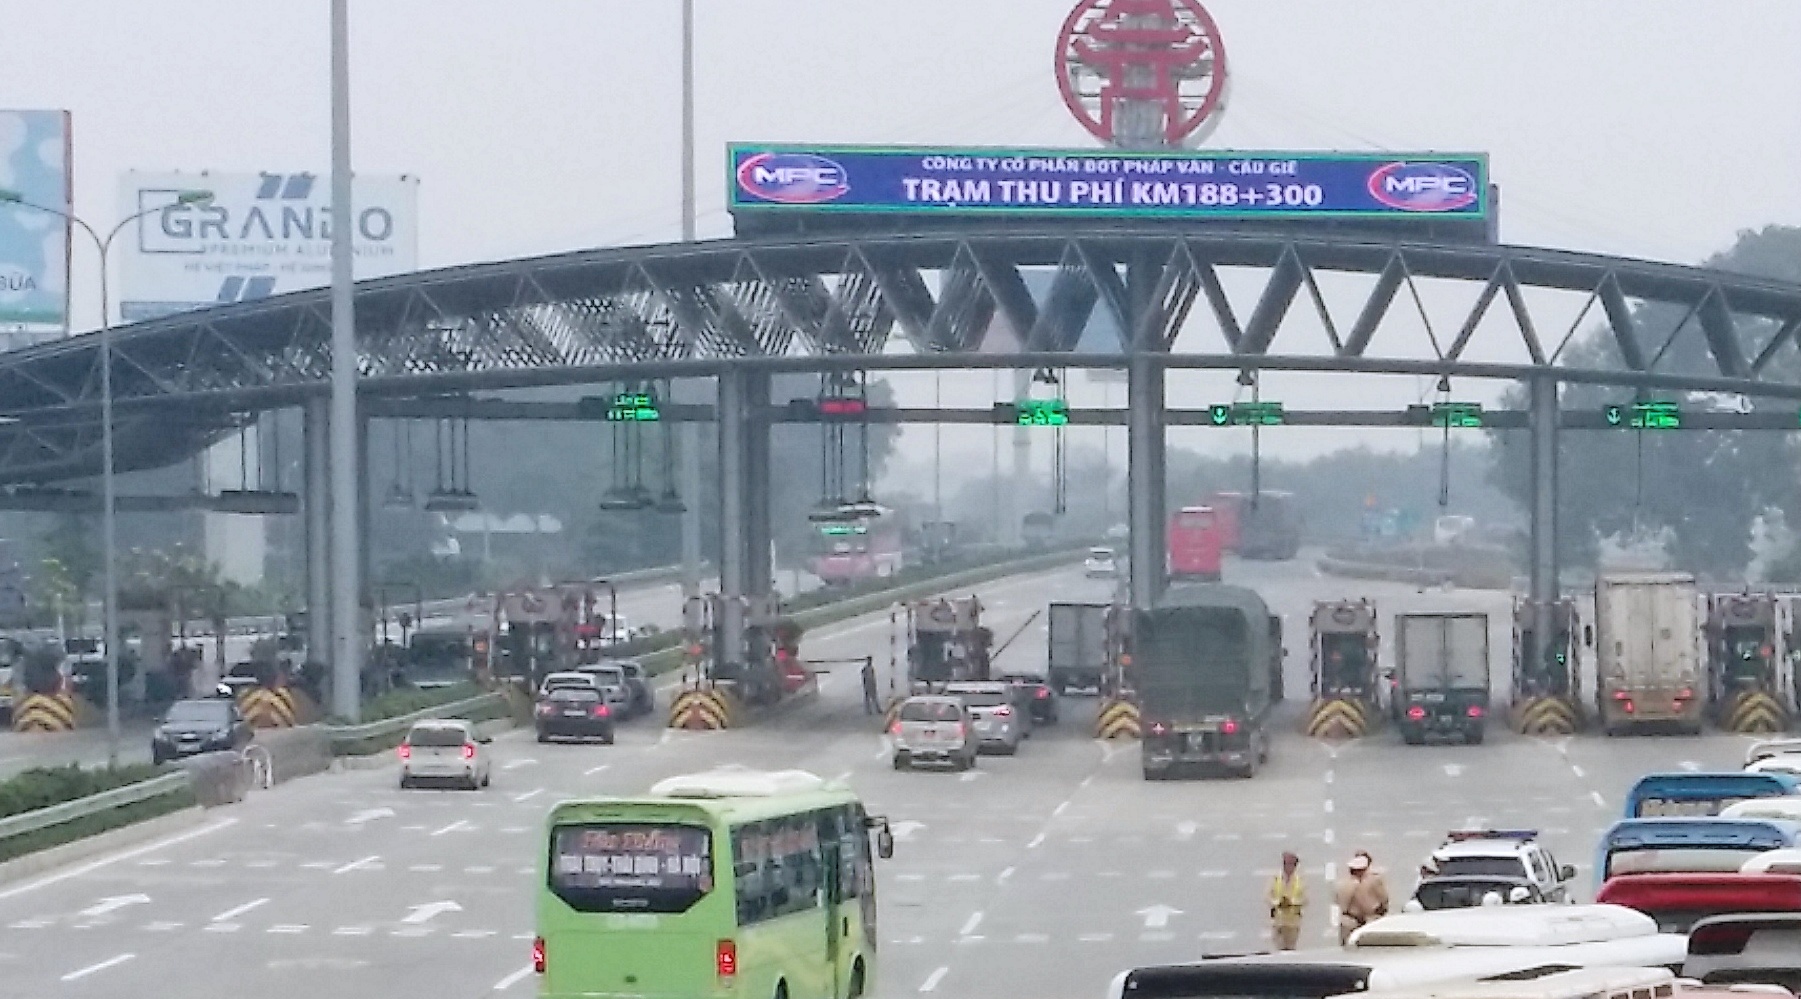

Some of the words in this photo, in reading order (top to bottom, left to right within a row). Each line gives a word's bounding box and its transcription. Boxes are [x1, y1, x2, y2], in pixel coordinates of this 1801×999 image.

[922, 156, 972, 171] CÔNG
[977, 158, 998, 171] TY
[754, 166, 838, 185] MPC
[902, 178, 991, 207] TRẠM
[999, 179, 1059, 203] THU
[1070, 176, 1124, 205] PHÍ
[1131, 183, 1324, 207] KM188+300
[1385, 176, 1469, 194] MPC
